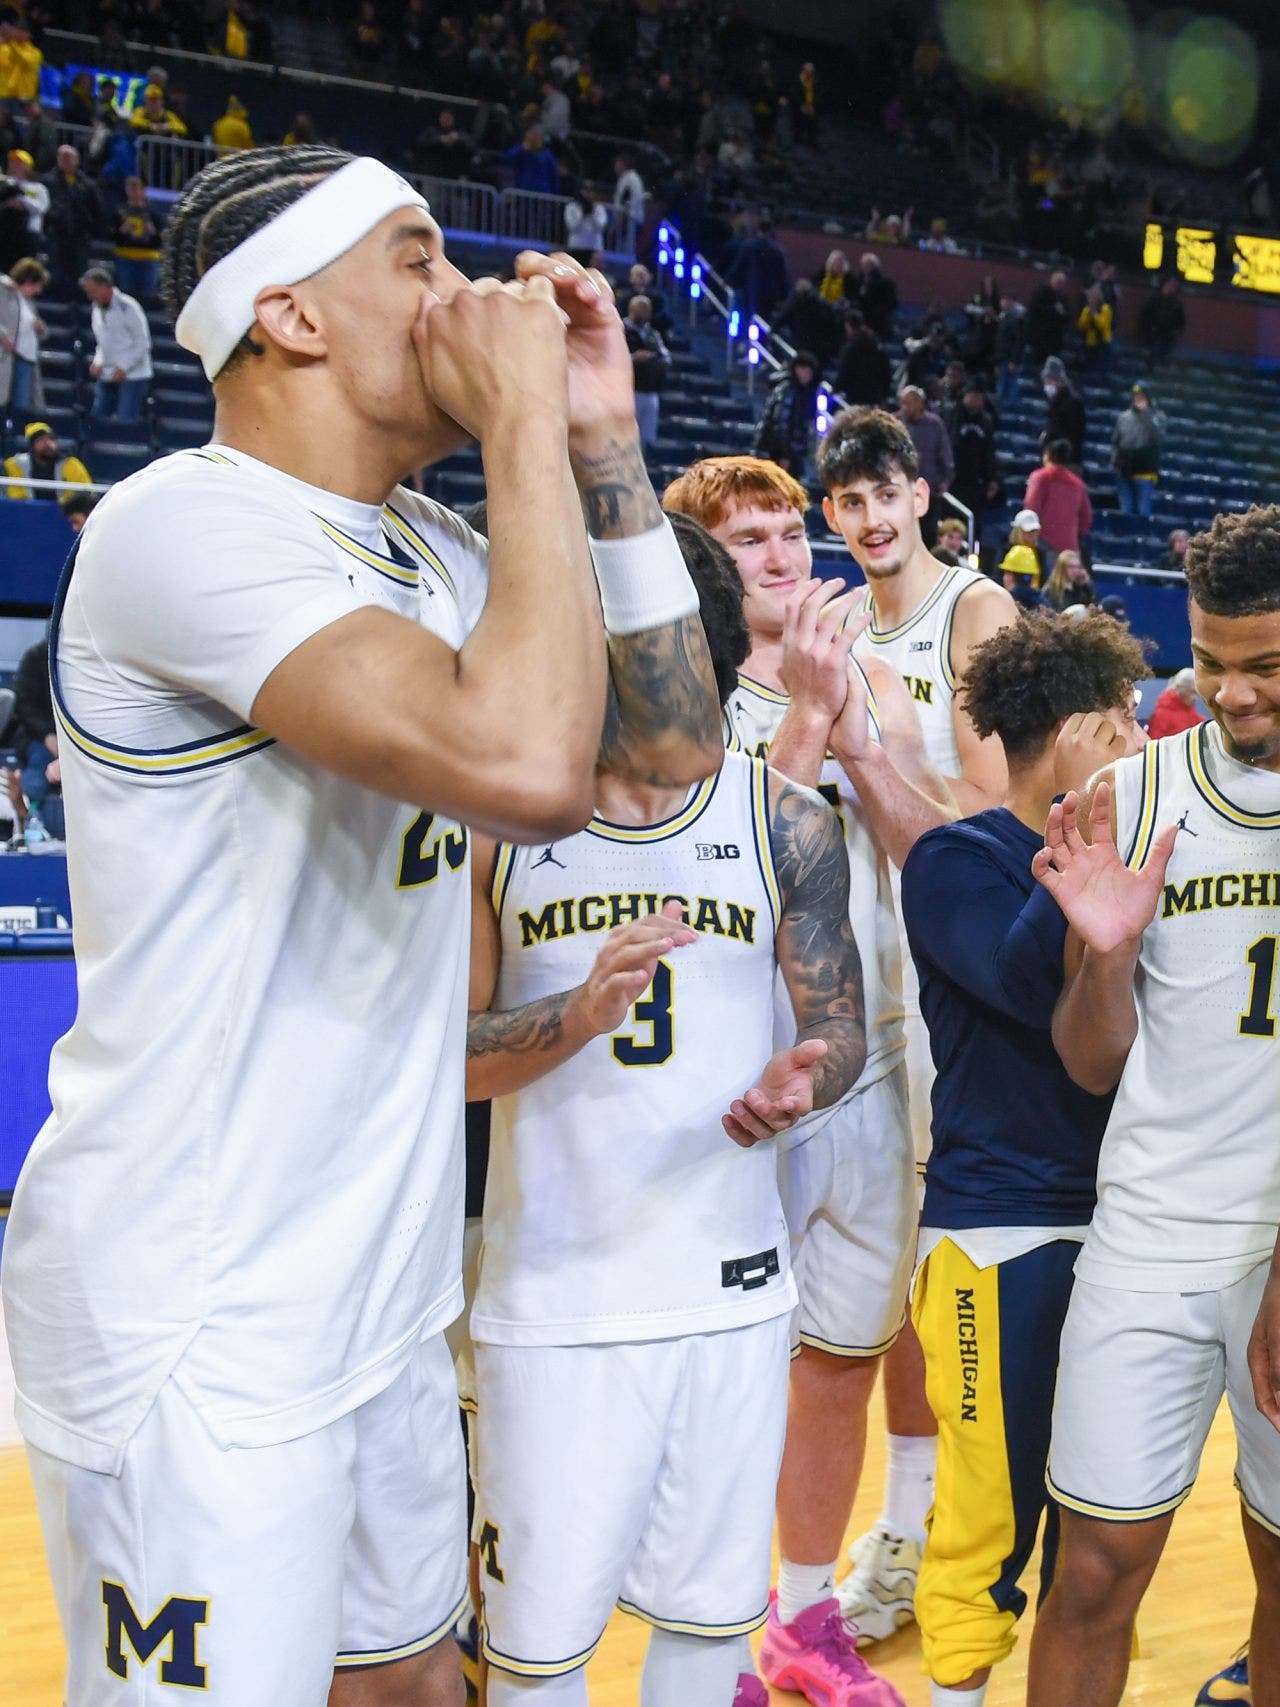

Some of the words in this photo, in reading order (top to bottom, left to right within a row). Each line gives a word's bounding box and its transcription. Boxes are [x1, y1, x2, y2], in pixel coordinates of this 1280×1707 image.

[611, 956, 677, 1068] 3
[1237, 934, 1280, 1040] 1
[955, 1288, 979, 1423] MICHIGAN
[101, 1578, 211, 1691] M
